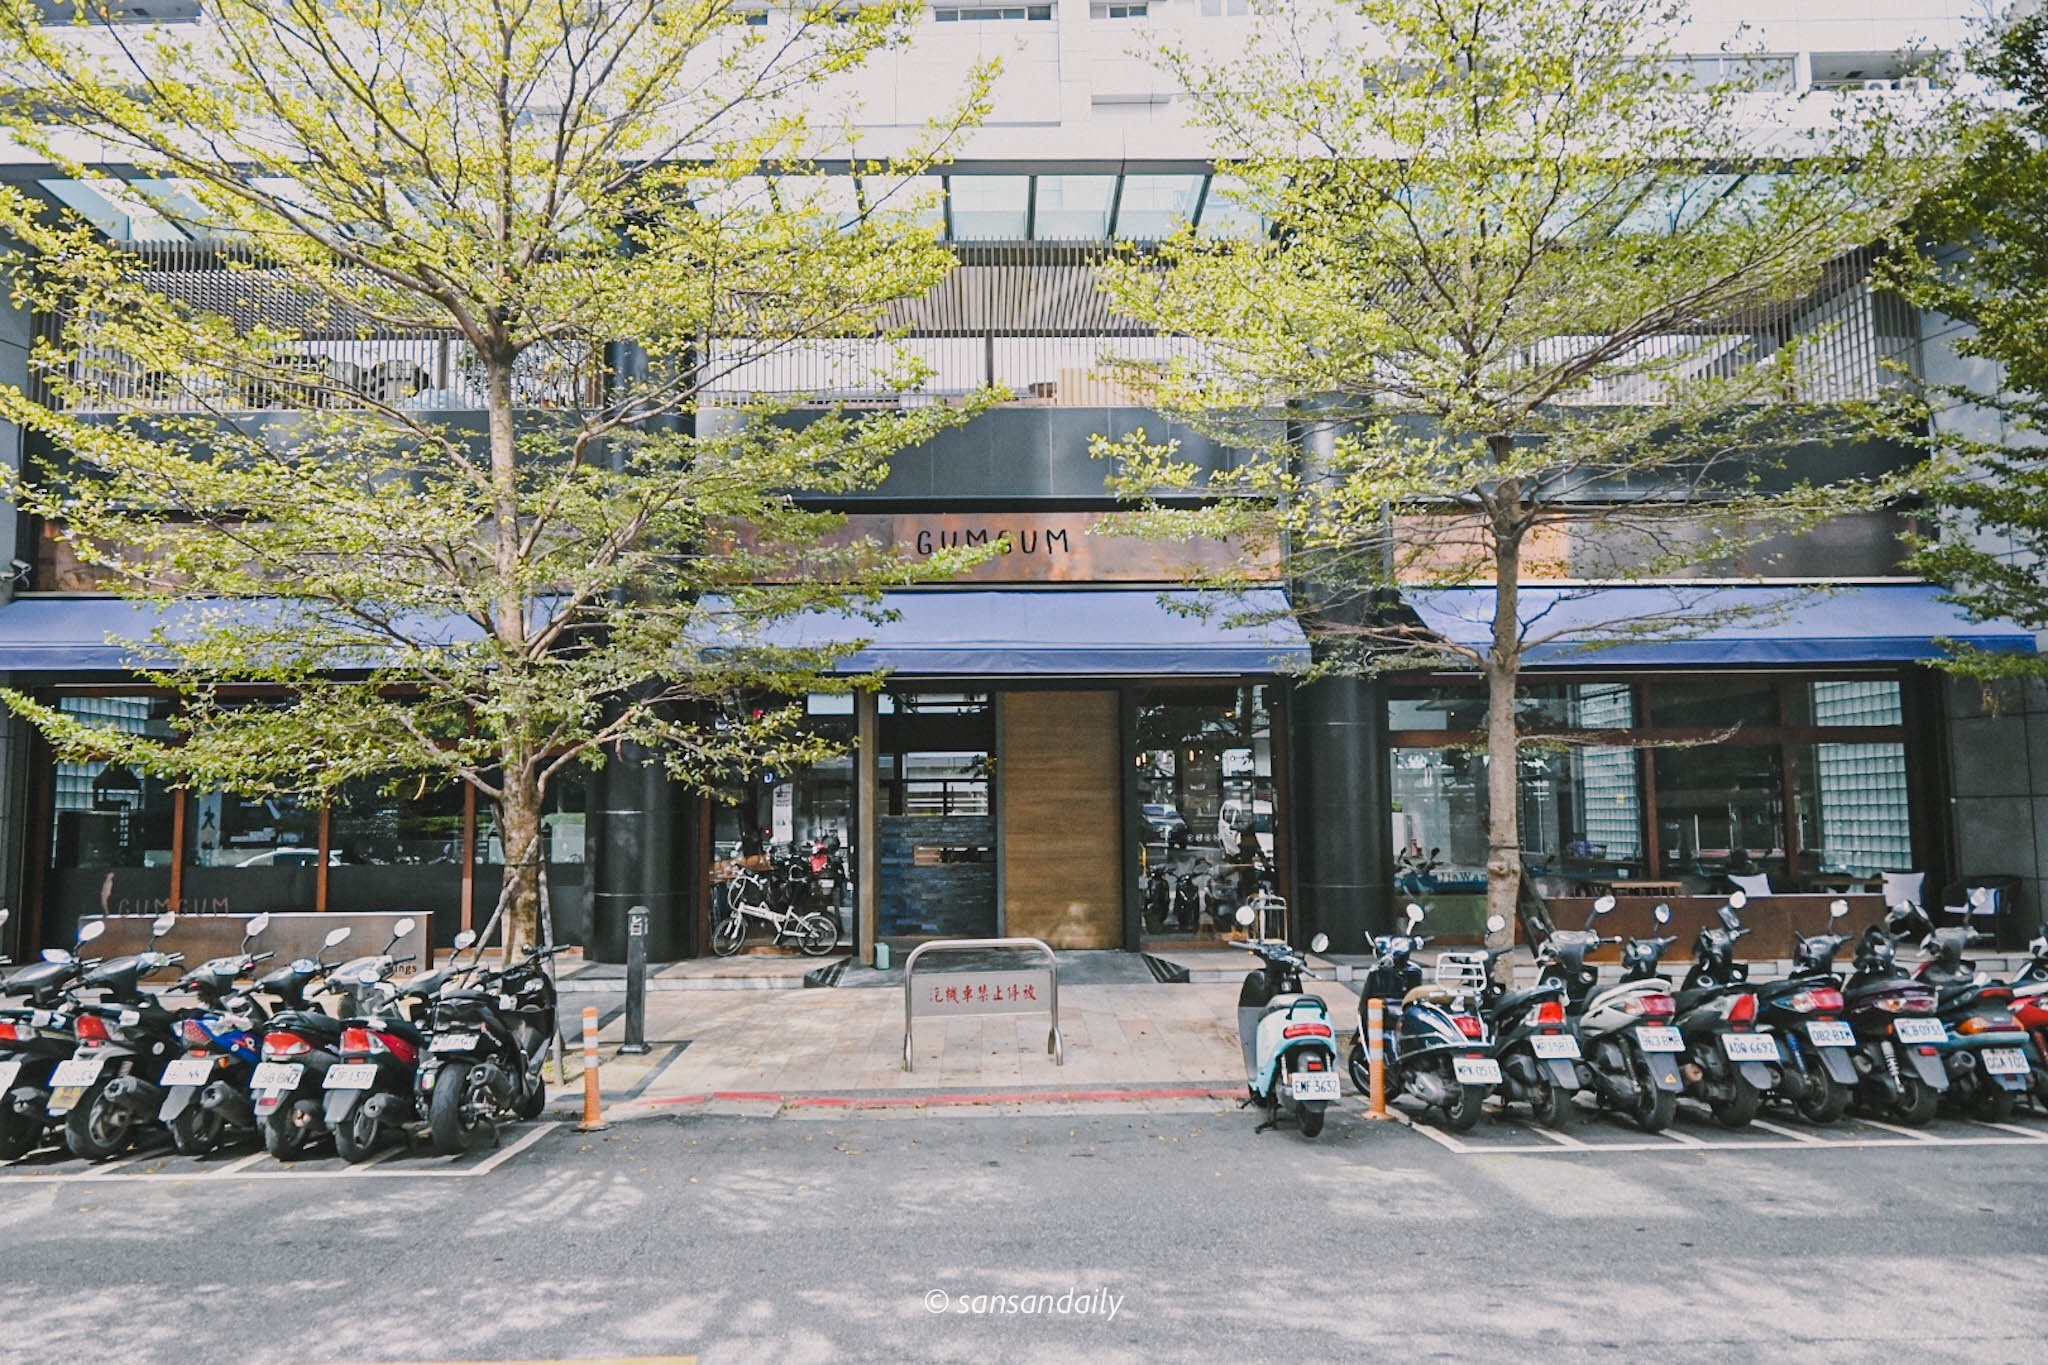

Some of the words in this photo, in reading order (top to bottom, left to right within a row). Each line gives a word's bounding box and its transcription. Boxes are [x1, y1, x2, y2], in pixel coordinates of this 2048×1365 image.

[929, 984, 1038, 1004] 汽機車禁止停放
